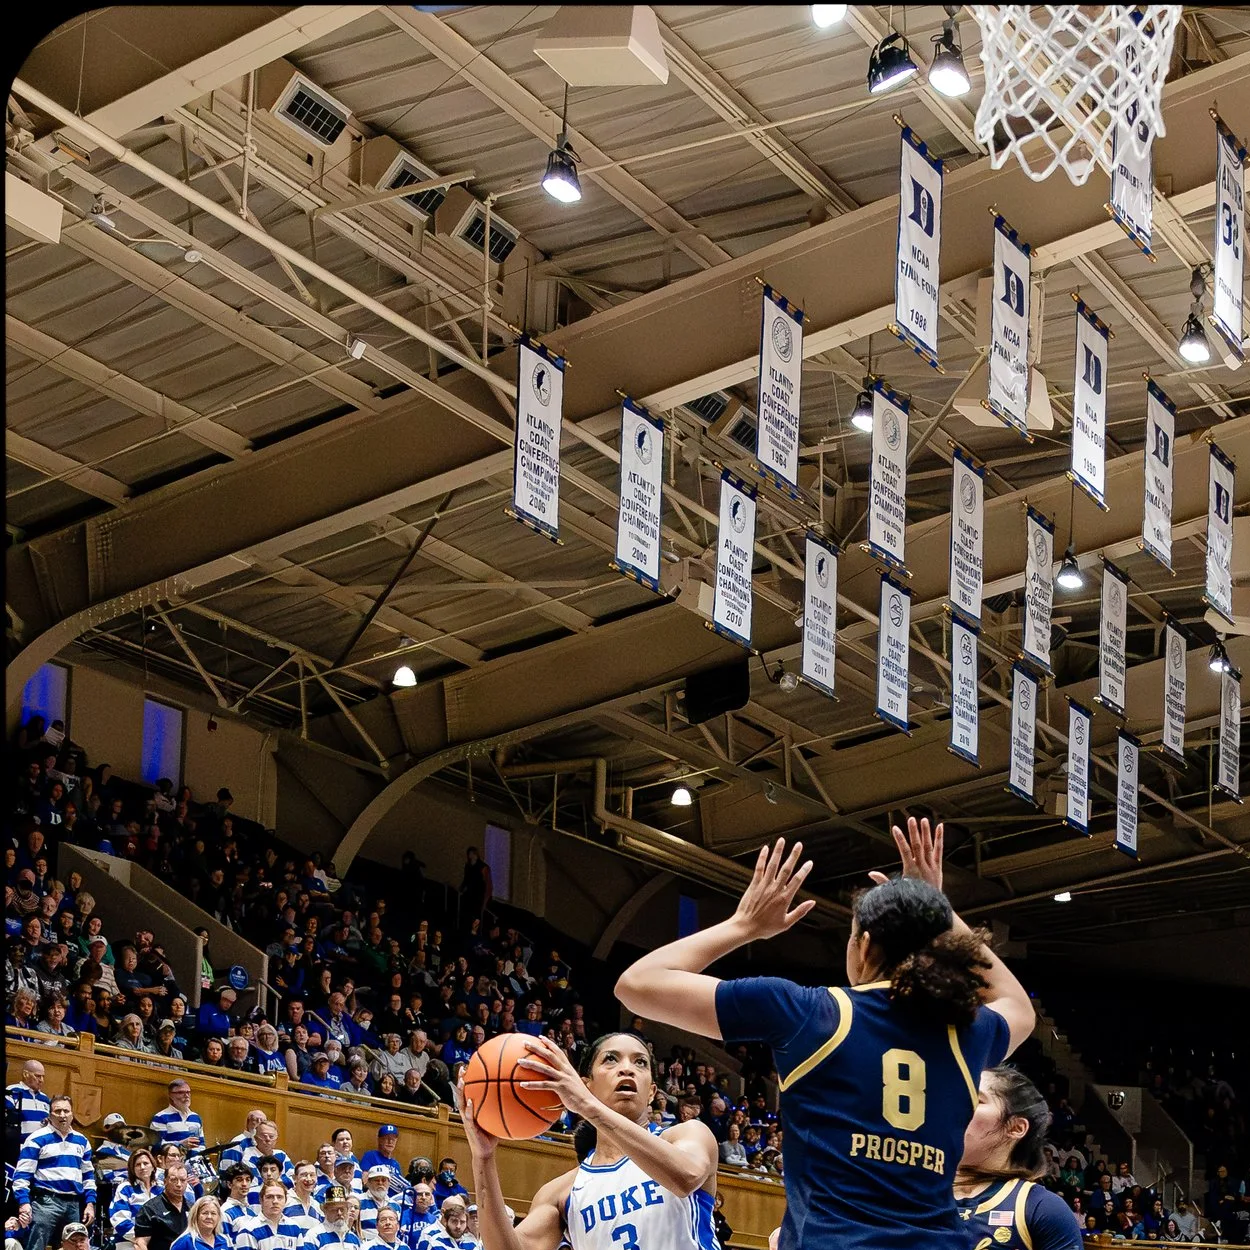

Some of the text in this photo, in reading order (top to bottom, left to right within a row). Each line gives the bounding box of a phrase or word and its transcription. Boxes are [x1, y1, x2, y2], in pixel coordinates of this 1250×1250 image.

[1223, 202, 1240, 260] 32
[911, 244, 930, 271] NCAA
[900, 260, 937, 303] FINAL FOUR
[909, 307, 927, 332] 1988
[1002, 325, 1021, 348] NCAA
[768, 365, 794, 395] ATLANTIC
[771, 384, 790, 406] COAST
[762, 391, 798, 429] CONFERENCE
[1085, 401, 1098, 425] NCAA
[526, 413, 555, 440] ATLANTIC
[763, 408, 797, 442] CHAMPIONS
[1076, 415, 1090, 440] FINAL
[519, 438, 559, 473] CONFERENCE
[529, 431, 551, 453] COAST
[521, 455, 557, 487] CHAMPIONS
[878, 454, 902, 479] ATLANTIC
[628, 471, 656, 496] ATLANTIC
[872, 479, 905, 510] CONFERENCE
[633, 487, 652, 508] COAST
[874, 494, 904, 523] CHAMPIONS
[621, 496, 659, 528] CONFERENCE
[622, 512, 658, 541] CHAMPIONS
[958, 518, 979, 540] ATLANTIC
[631, 547, 648, 566] 2009
[724, 538, 749, 563] ATLANTIC
[729, 554, 745, 573] COAST
[953, 541, 983, 569] CONFERENCE
[718, 562, 752, 592] CONFERENCE
[954, 556, 981, 582] CHAMPIONS
[719, 576, 750, 604] CHAMPIONS
[725, 610, 743, 627] 2010
[814, 662, 828, 678] 2011
[881, 1048, 927, 1132] 8
[849, 1133, 945, 1176] PROSPER
[580, 1180, 665, 1234] DUKE
